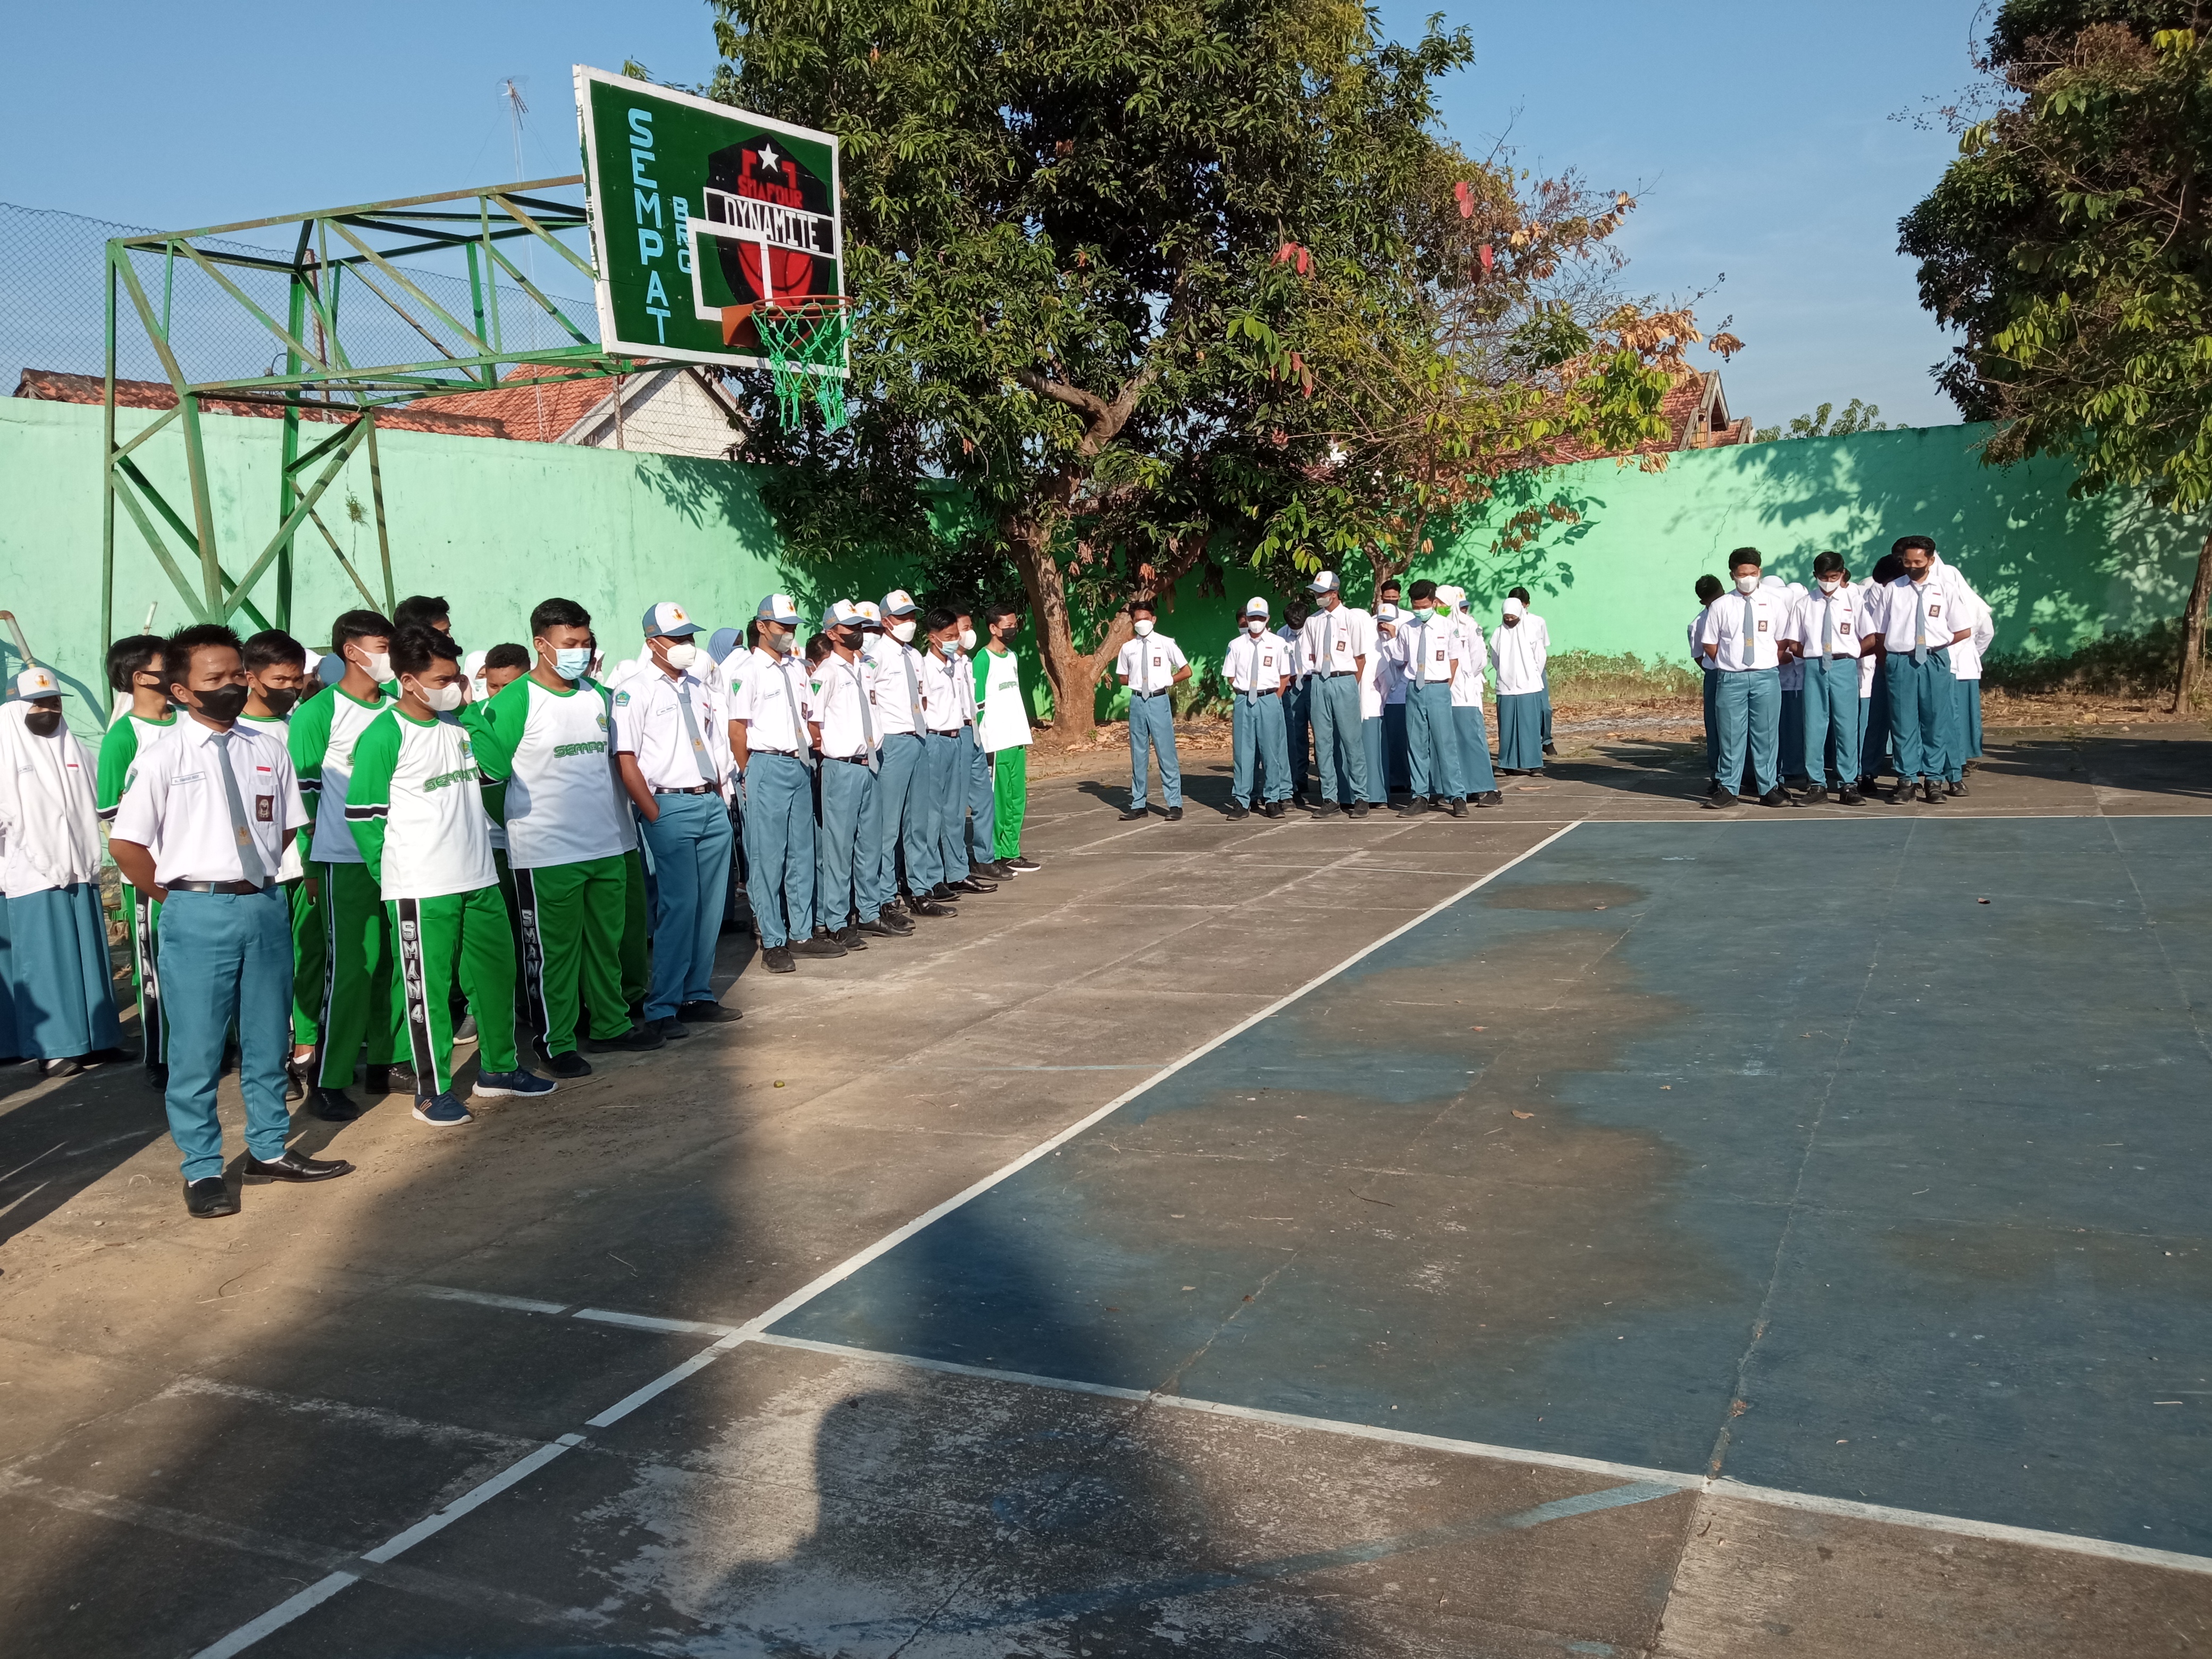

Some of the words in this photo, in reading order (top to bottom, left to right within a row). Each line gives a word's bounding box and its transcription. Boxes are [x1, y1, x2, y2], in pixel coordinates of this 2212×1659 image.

[627, 107, 672, 345] SEMPAT
[724, 195, 820, 252] DYNAMITE
[401, 920, 421, 1000] SMAN
[522, 909, 540, 977] SMAN
[144, 981, 156, 999] 4
[410, 1004, 424, 1023] 4
